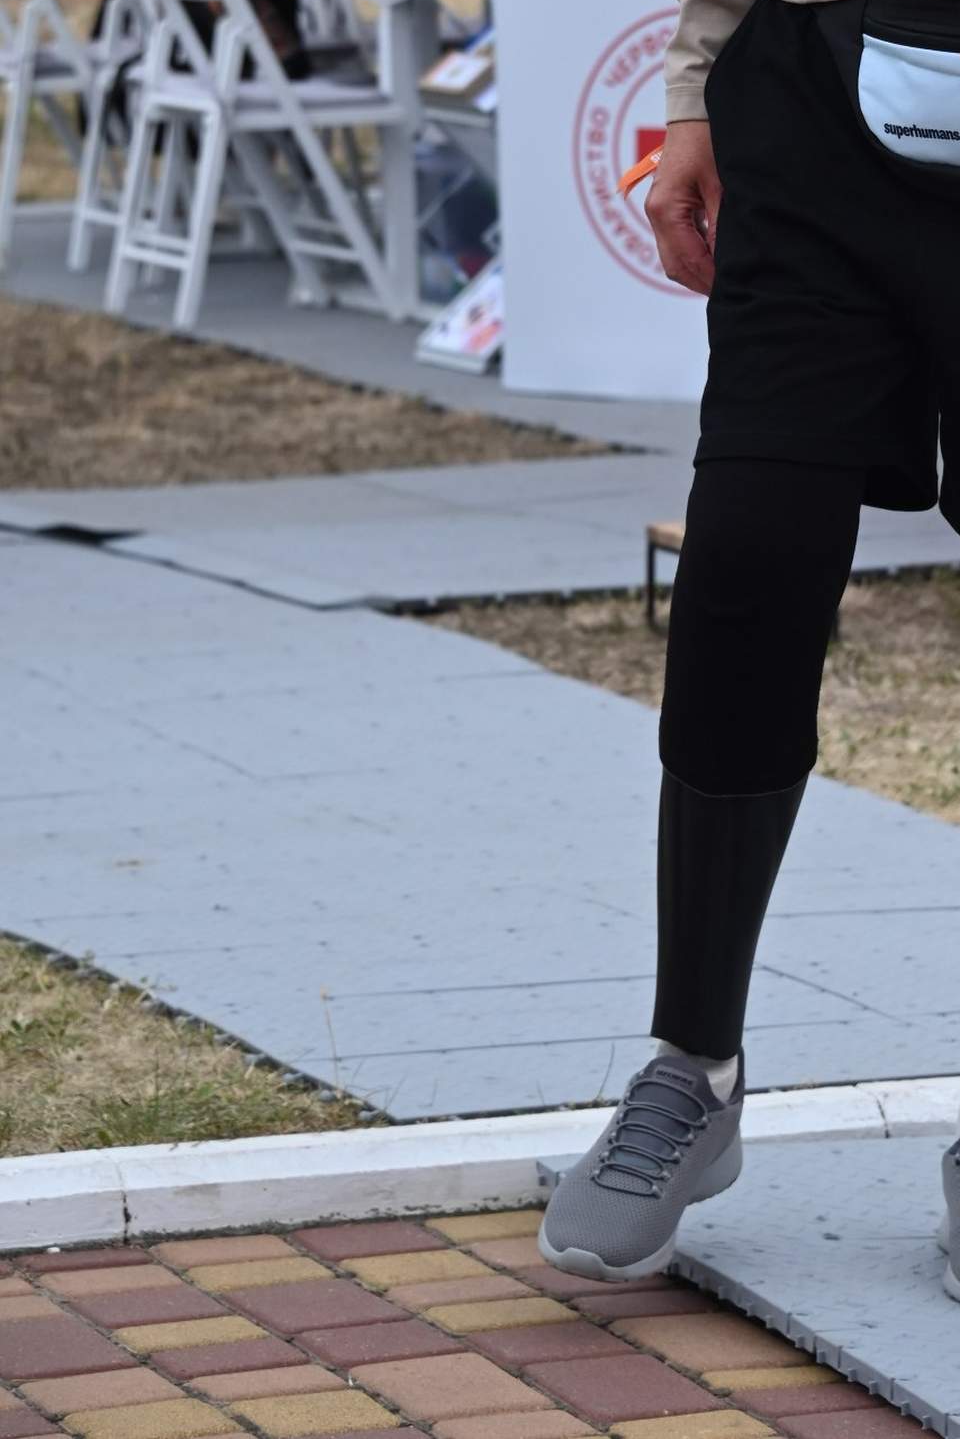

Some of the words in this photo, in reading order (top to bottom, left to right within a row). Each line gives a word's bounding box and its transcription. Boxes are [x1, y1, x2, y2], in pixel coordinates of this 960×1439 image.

[603, 26, 676, 88] ЧЕРВО
[883, 122, 960, 141] superhumans
[585, 105, 664, 274] ОВАРИСТВО
